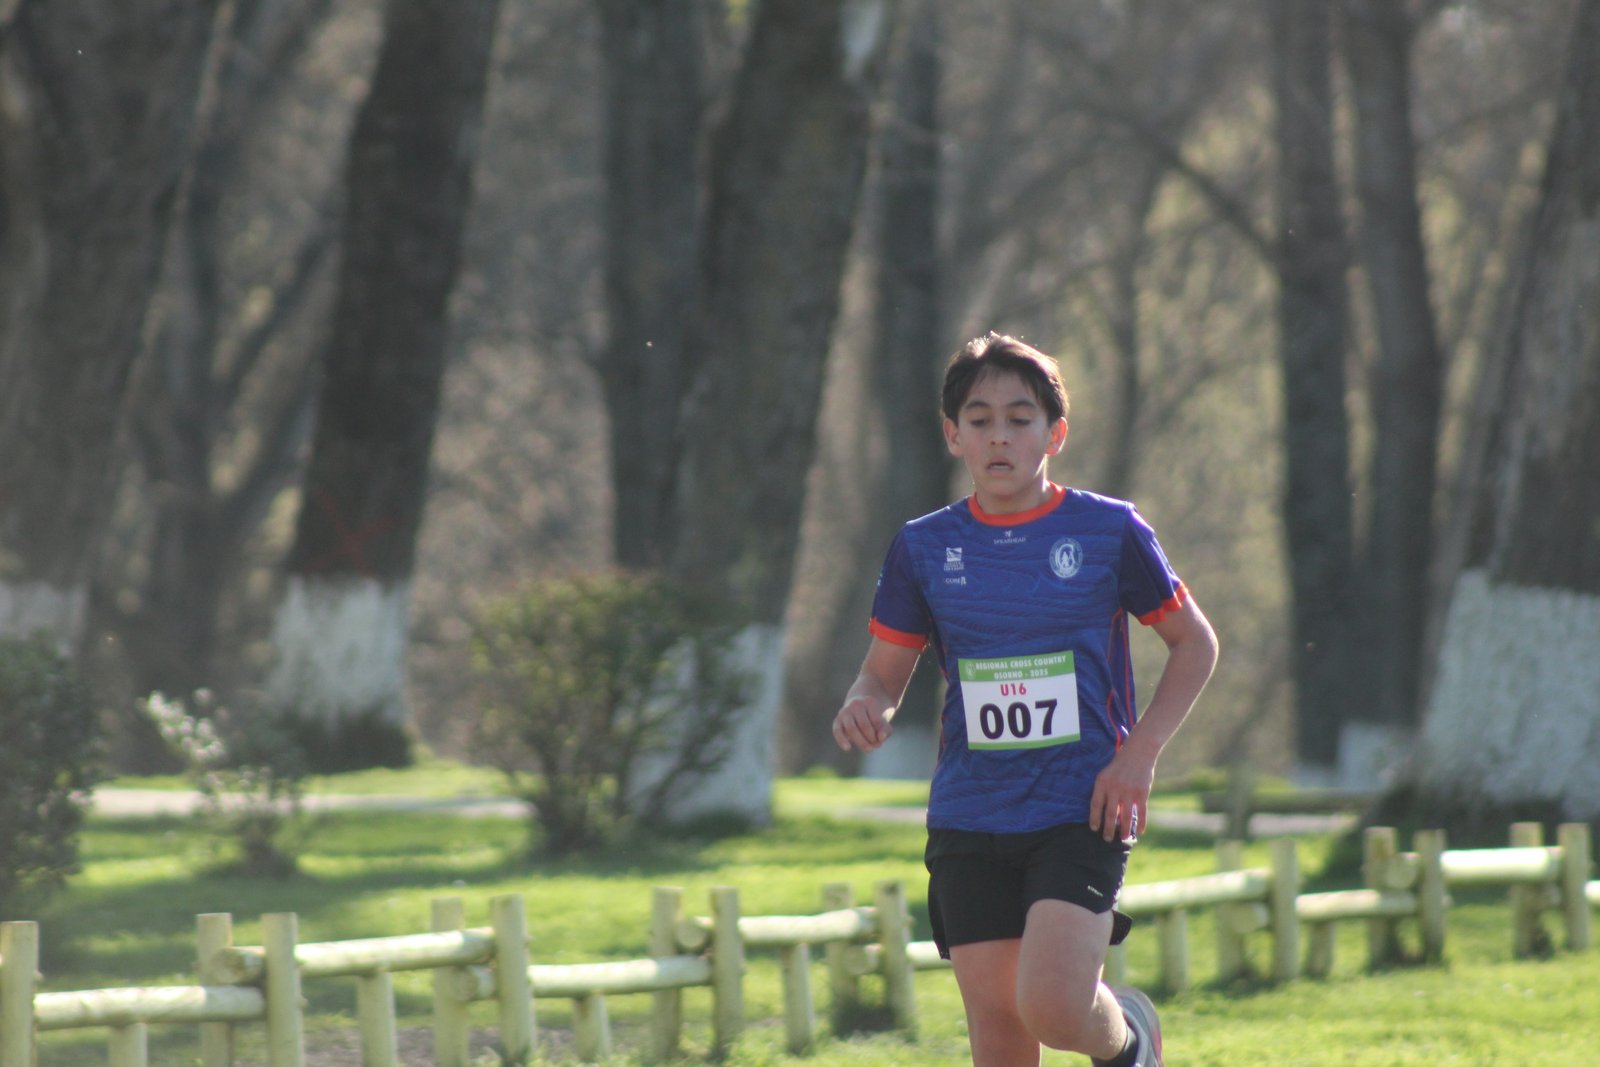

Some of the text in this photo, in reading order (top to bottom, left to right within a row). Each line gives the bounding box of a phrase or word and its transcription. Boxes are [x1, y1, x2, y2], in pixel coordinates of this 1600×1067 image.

[975, 655, 1067, 670] REGIONAL CROSS COUNTRY
[994, 671, 1023, 680] OSORNO
[1000, 683, 1027, 696] U16
[979, 698, 1057, 740] 007
